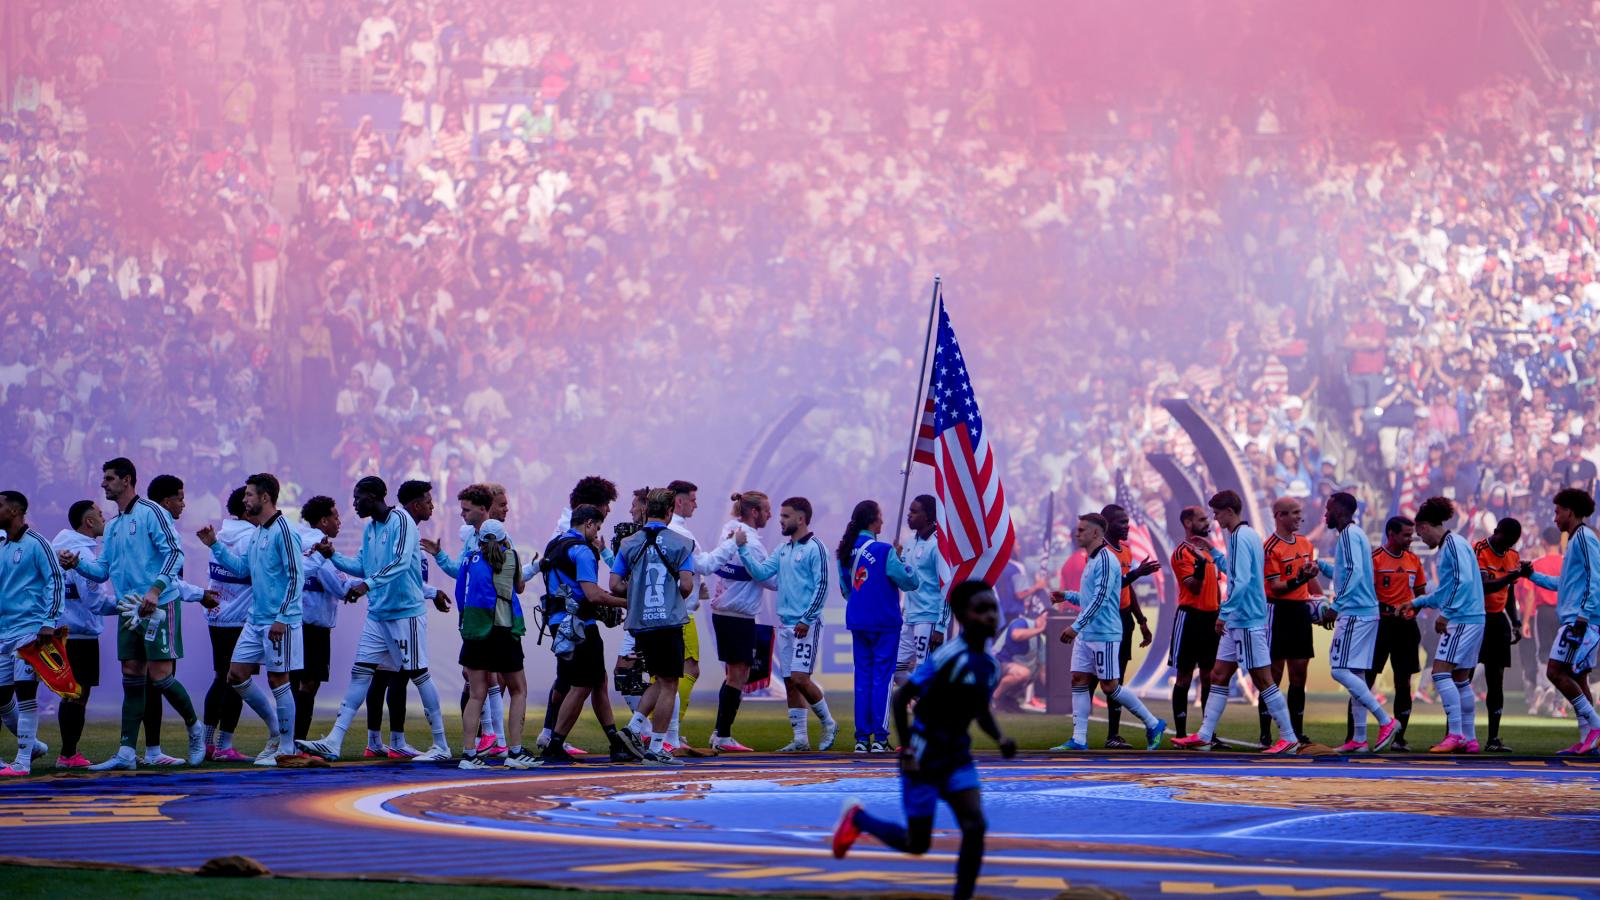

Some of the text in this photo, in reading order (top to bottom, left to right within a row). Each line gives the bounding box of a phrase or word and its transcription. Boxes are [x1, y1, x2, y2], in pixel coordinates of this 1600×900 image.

[642, 612, 667, 620] 2026
[161, 628, 167, 645] 1
[1440, 632, 1451, 647] 3
[795, 643, 812, 659] 23
[568, 861, 1068, 890] FIFA
